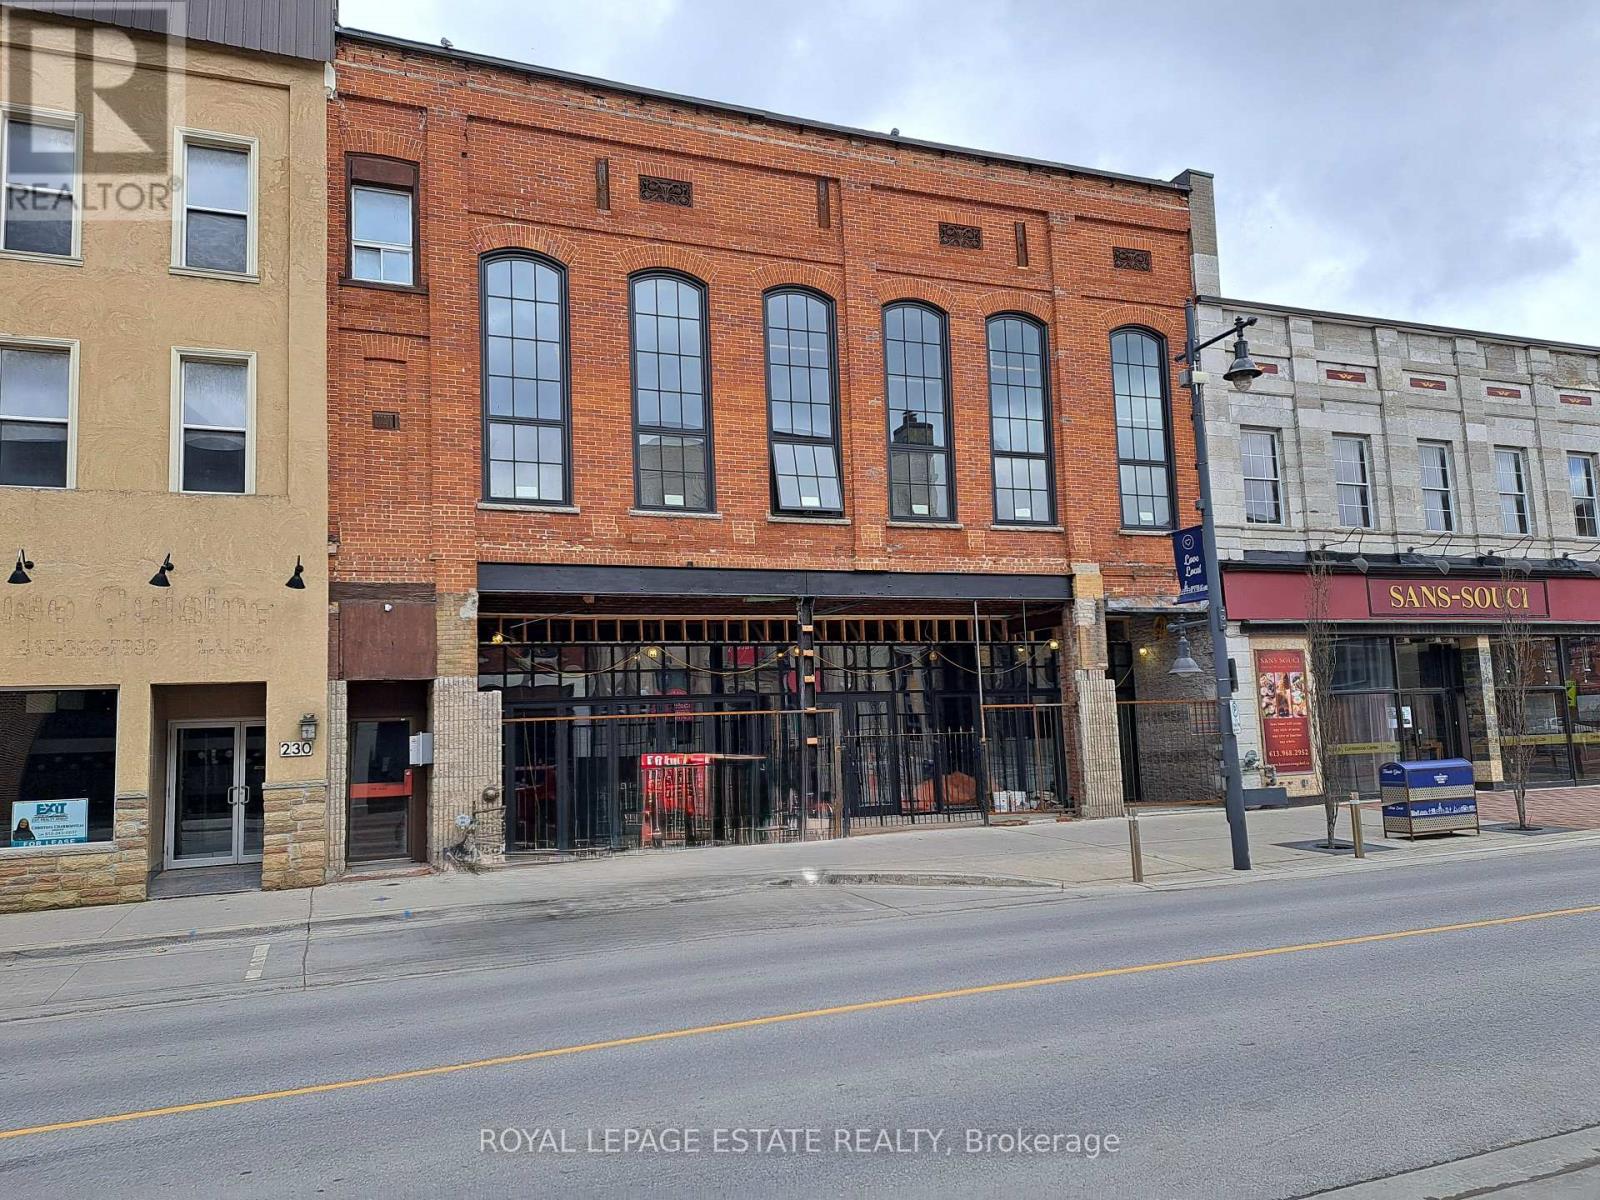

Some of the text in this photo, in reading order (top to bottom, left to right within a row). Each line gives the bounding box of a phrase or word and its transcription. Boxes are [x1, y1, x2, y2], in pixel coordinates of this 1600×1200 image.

[1389, 585, 1529, 609] SANS-SOUCI
[281, 741, 312, 755] 230
[36, 802, 67, 815] EXIT
[45, 838, 76, 846] LEASE
